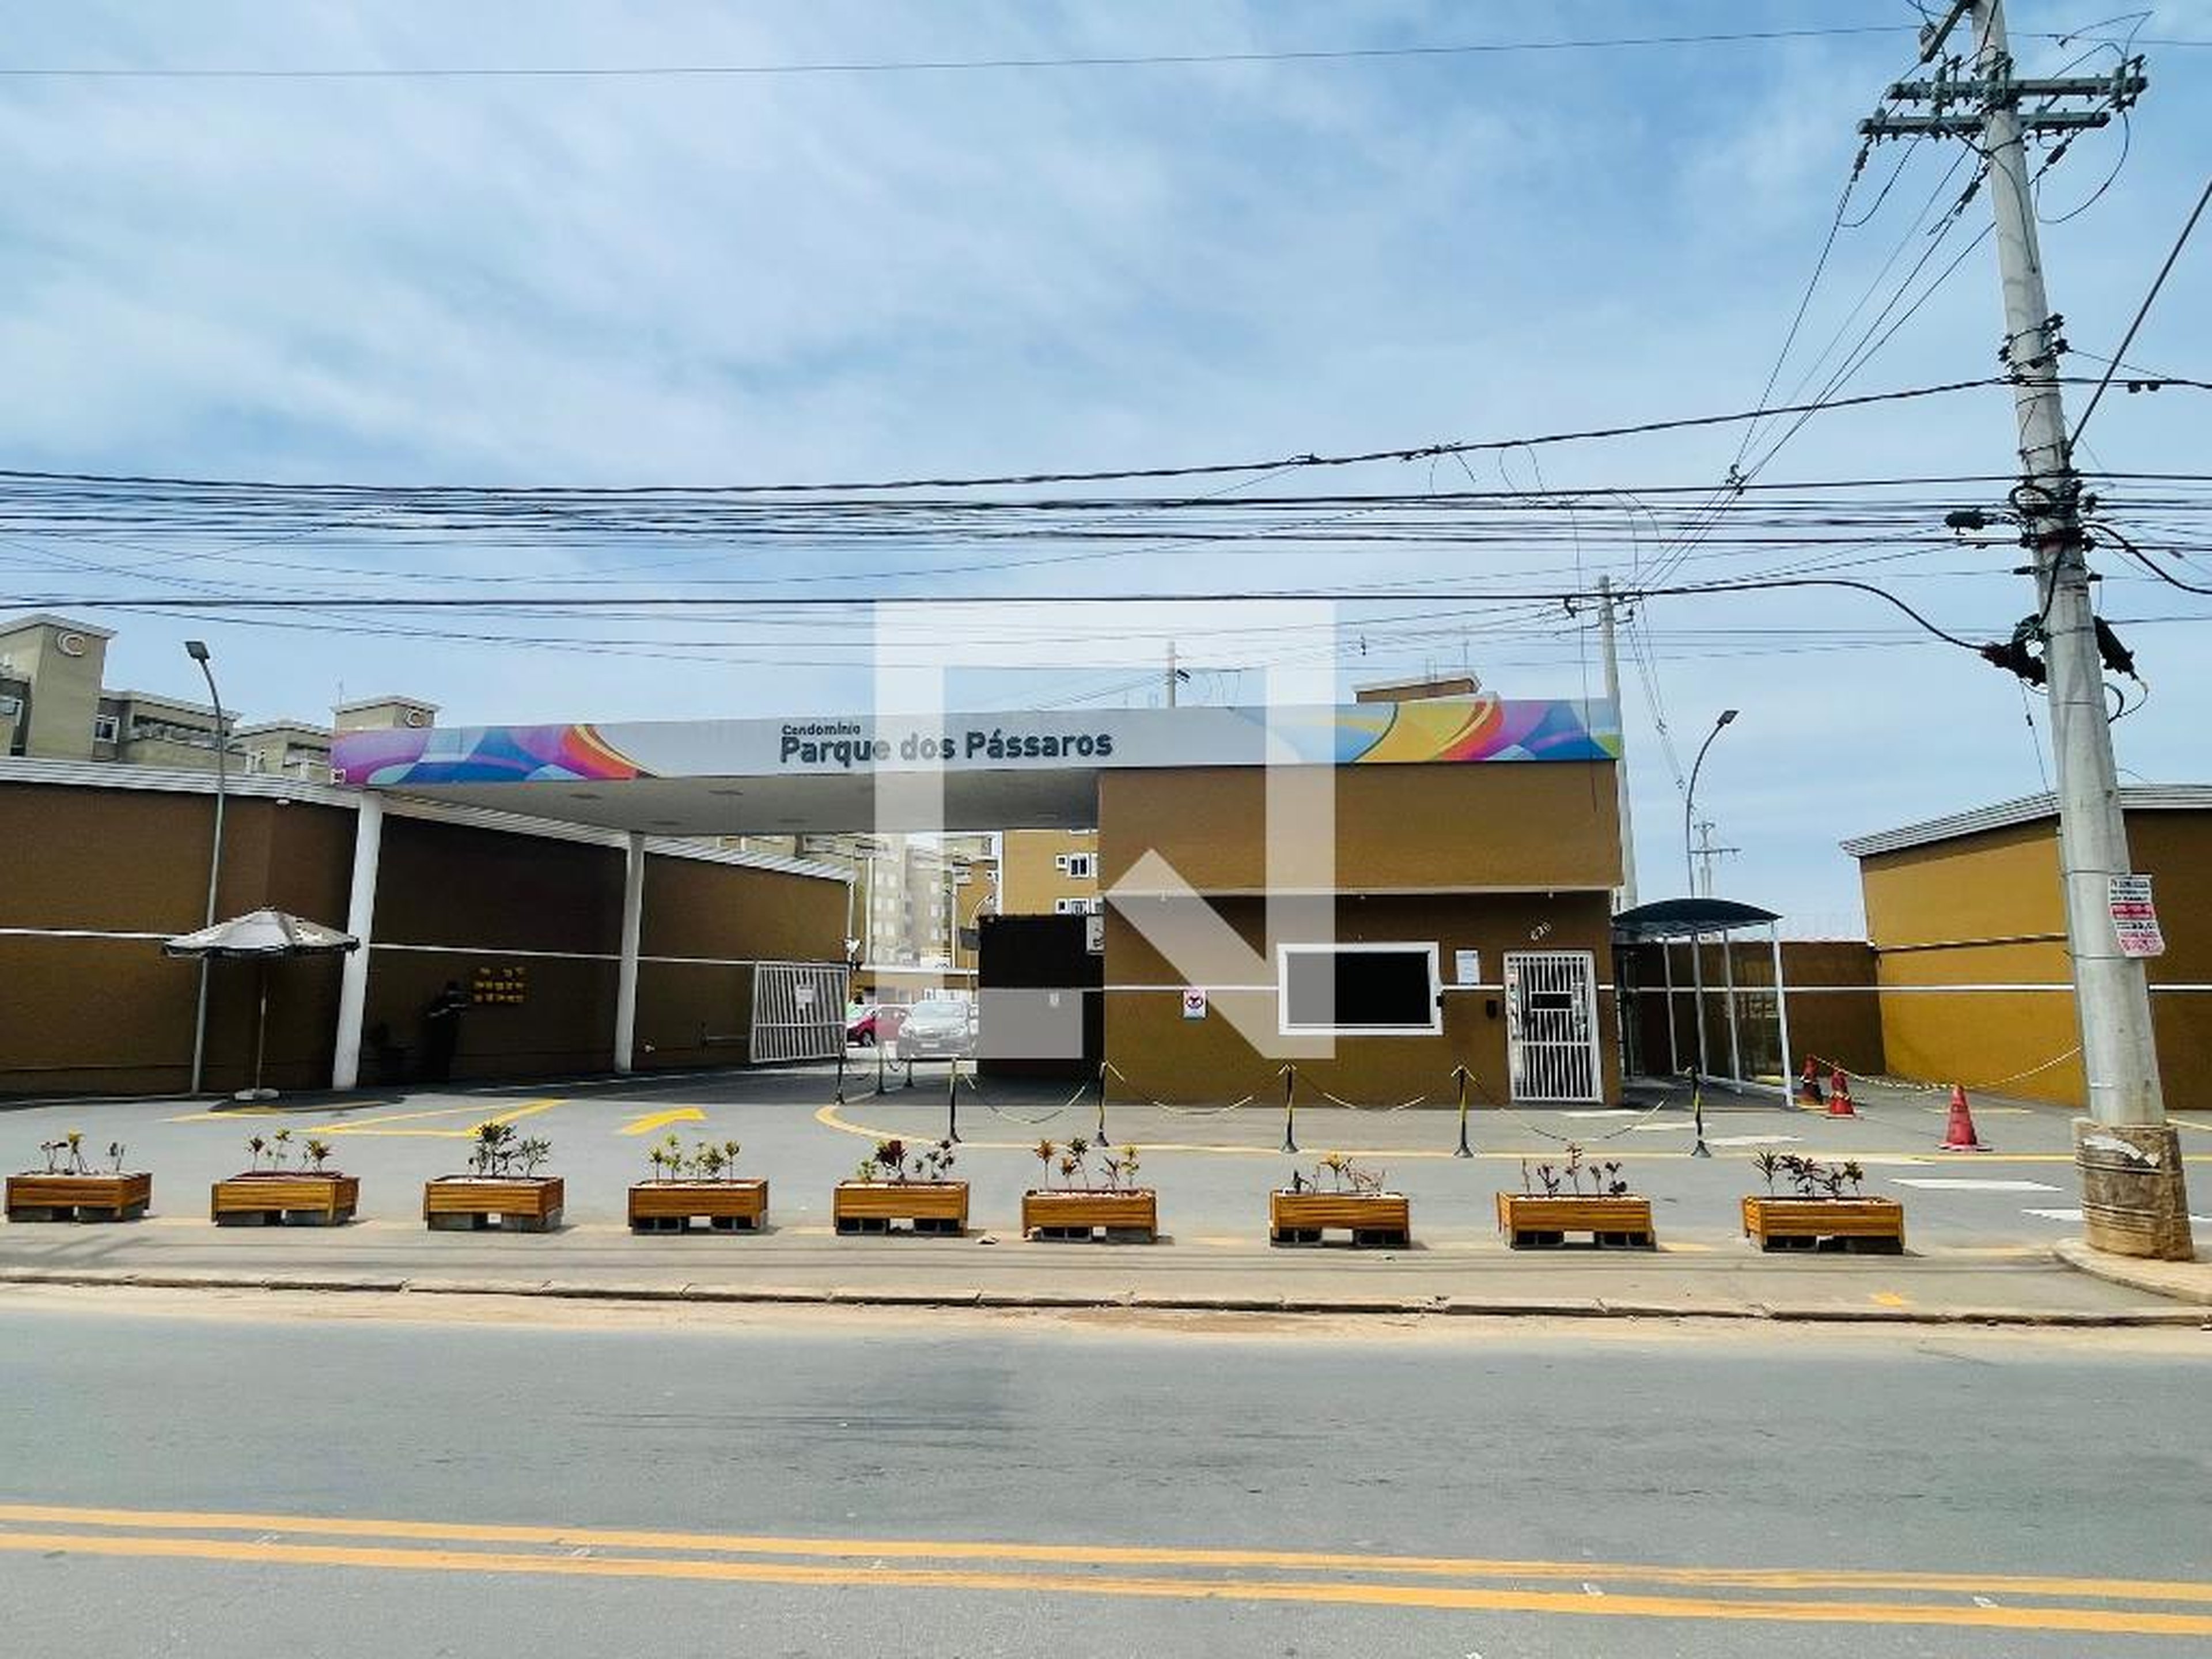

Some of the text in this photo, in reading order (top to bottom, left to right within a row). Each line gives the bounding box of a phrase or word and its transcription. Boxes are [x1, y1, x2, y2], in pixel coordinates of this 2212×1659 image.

[781, 728, 1113, 768] Parque dos Pássaros
